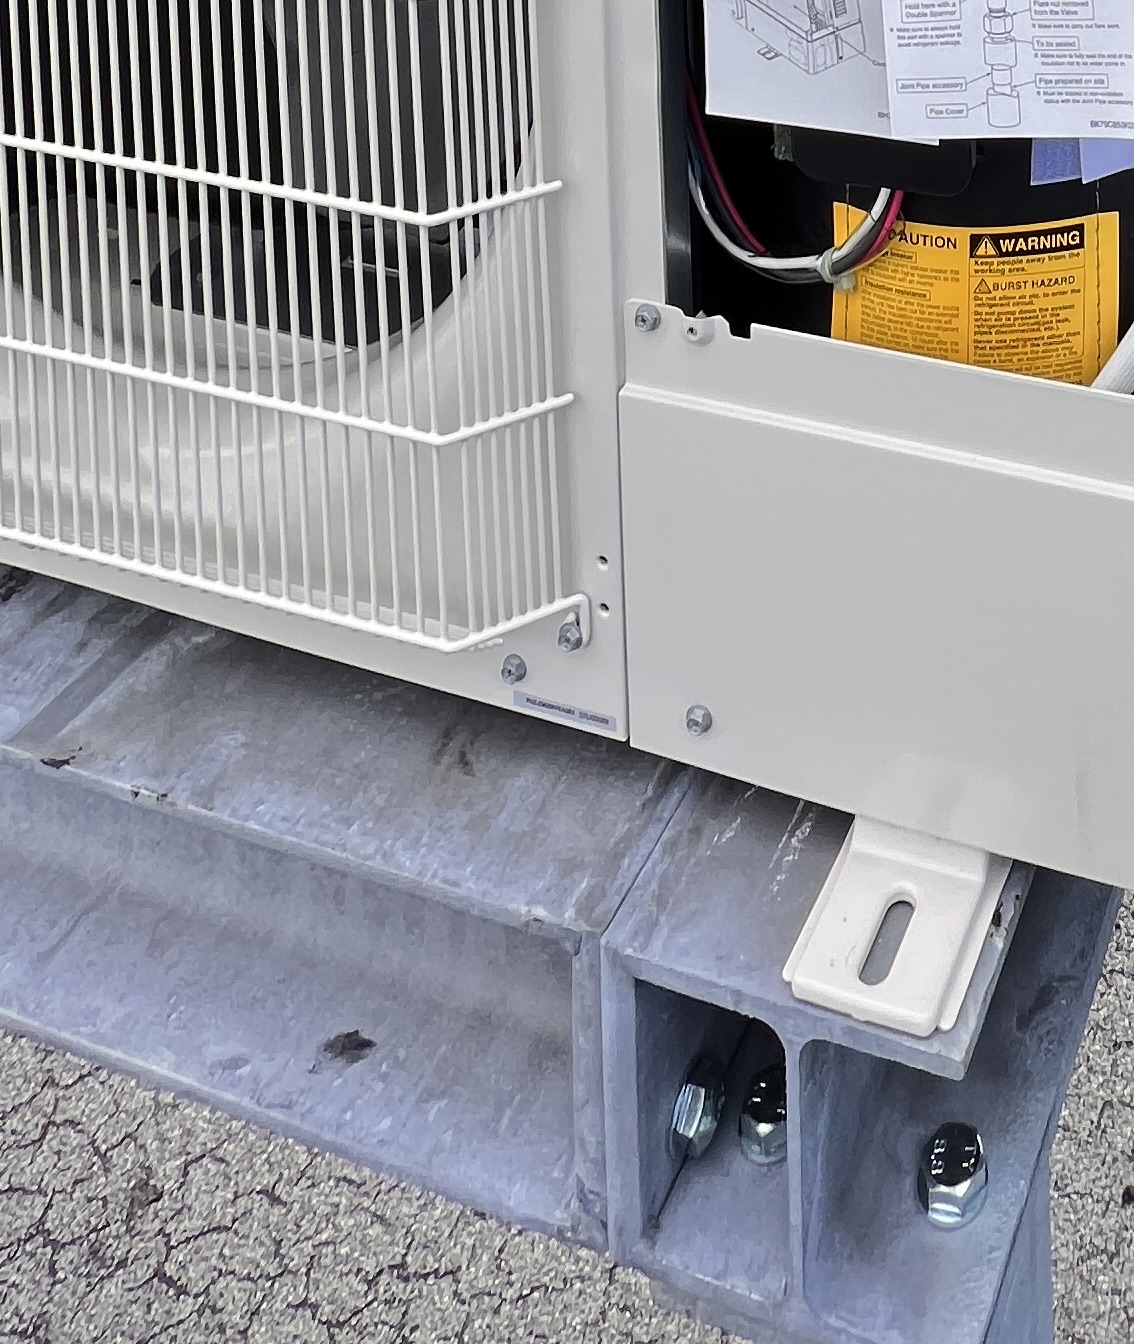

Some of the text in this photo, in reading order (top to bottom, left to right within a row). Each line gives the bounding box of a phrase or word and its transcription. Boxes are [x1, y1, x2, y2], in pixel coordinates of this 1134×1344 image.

[1000, 231, 1080, 252] WARNING
[974, 259, 994, 268] Keep
[997, 258, 1023, 266] people
[993, 276, 1075, 291] BURST HAZARD
